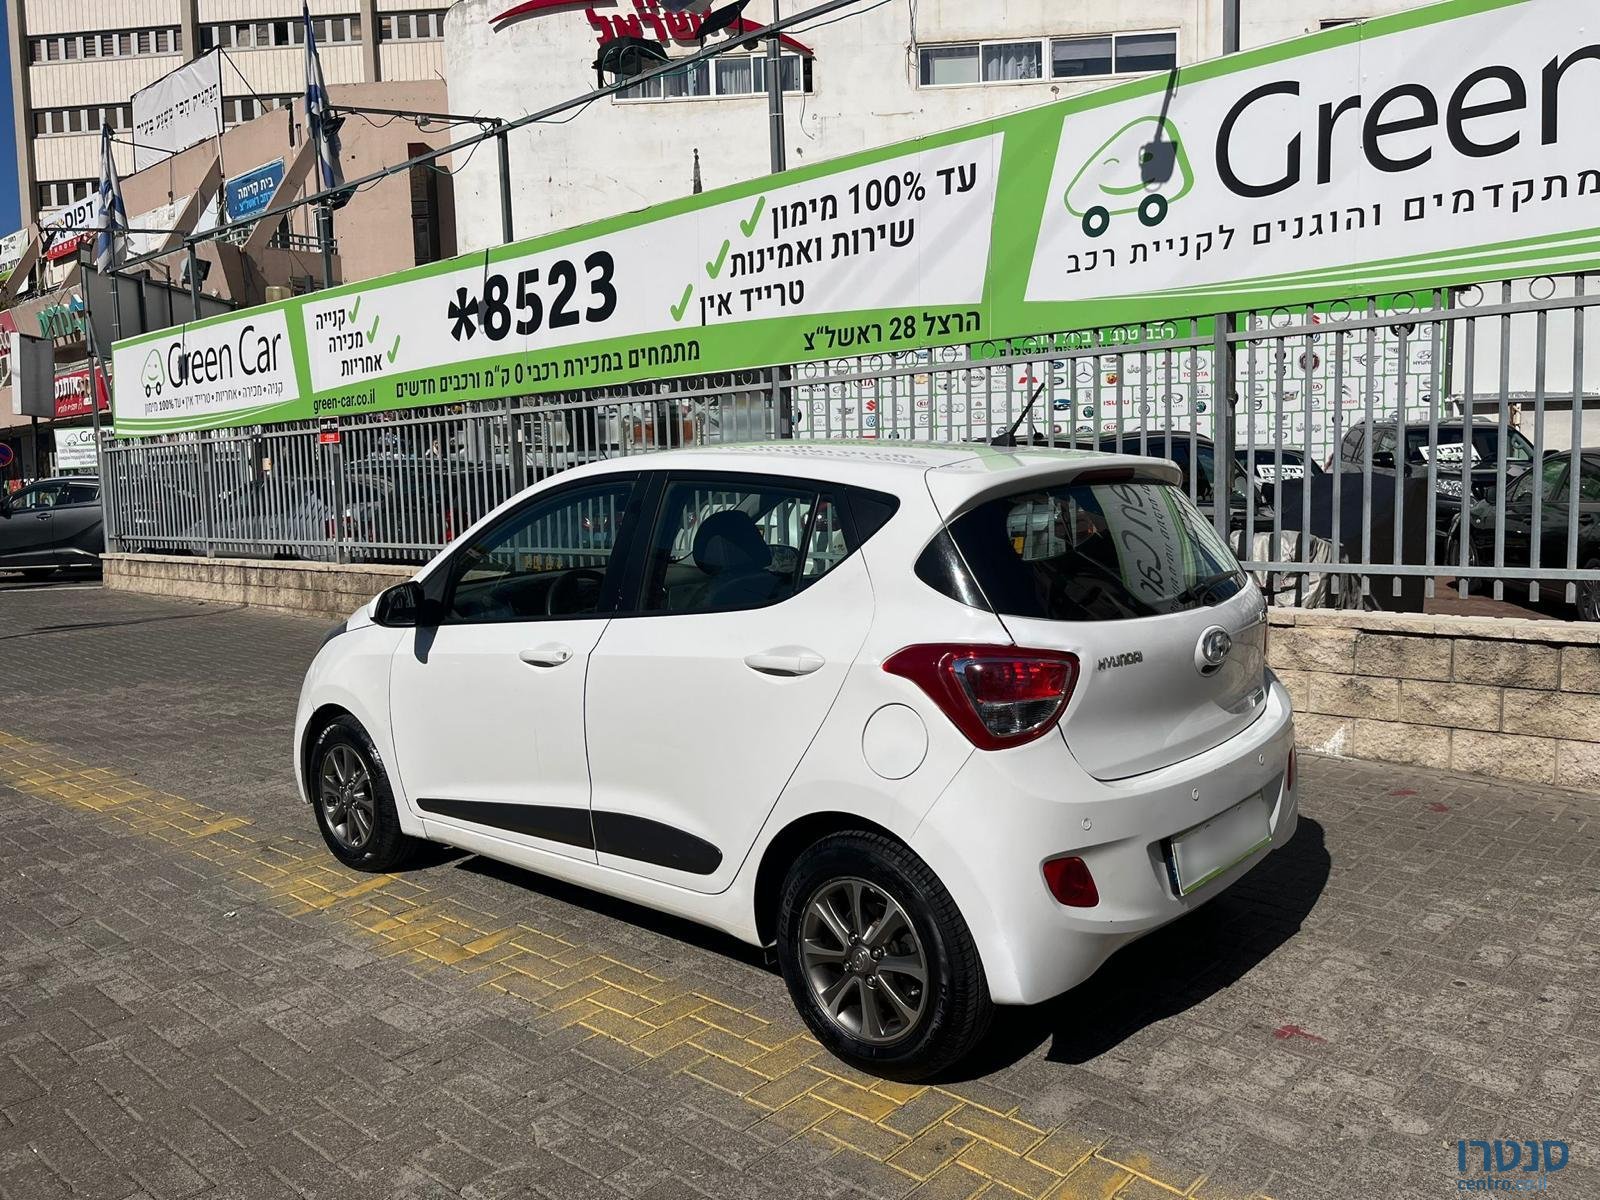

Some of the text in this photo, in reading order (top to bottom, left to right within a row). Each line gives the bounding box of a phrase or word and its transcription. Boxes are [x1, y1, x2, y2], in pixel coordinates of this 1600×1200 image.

[237, 176, 274, 200] בית קדימה
[771, 162, 977, 239] עד 100% מימון
[64, 201, 94, 229] דפוס
[1066, 168, 1600, 274] מתקדמים והוגנים לקניית רכב
[730, 218, 915, 278] שירות ואמינות
[699, 279, 805, 326] טרייד אין
[315, 308, 346, 331] קנייה
[804, 310, 981, 351] הרצל 28 ראשל"צ
[328, 331, 364, 353] מכירה
[167, 325, 282, 388] Green Car
[341, 353, 383, 376] אחריות
[563, 350, 624, 378] במכירת
[628, 339, 700, 370] מתמחים
[440, 374, 480, 392] ורכבים
[514, 363, 524, 384] 0
[527, 361, 559, 383] רכבי
[215, 388, 238, 402] אחריות
[242, 384, 262, 399] מכירה
[267, 381, 283, 395] קניה
[396, 378, 436, 398] חדשים
[159, 400, 174, 411] 100%
[313, 388, 376, 414] green-car.co.il
[1096, 650, 1144, 671] HYUNDAI
